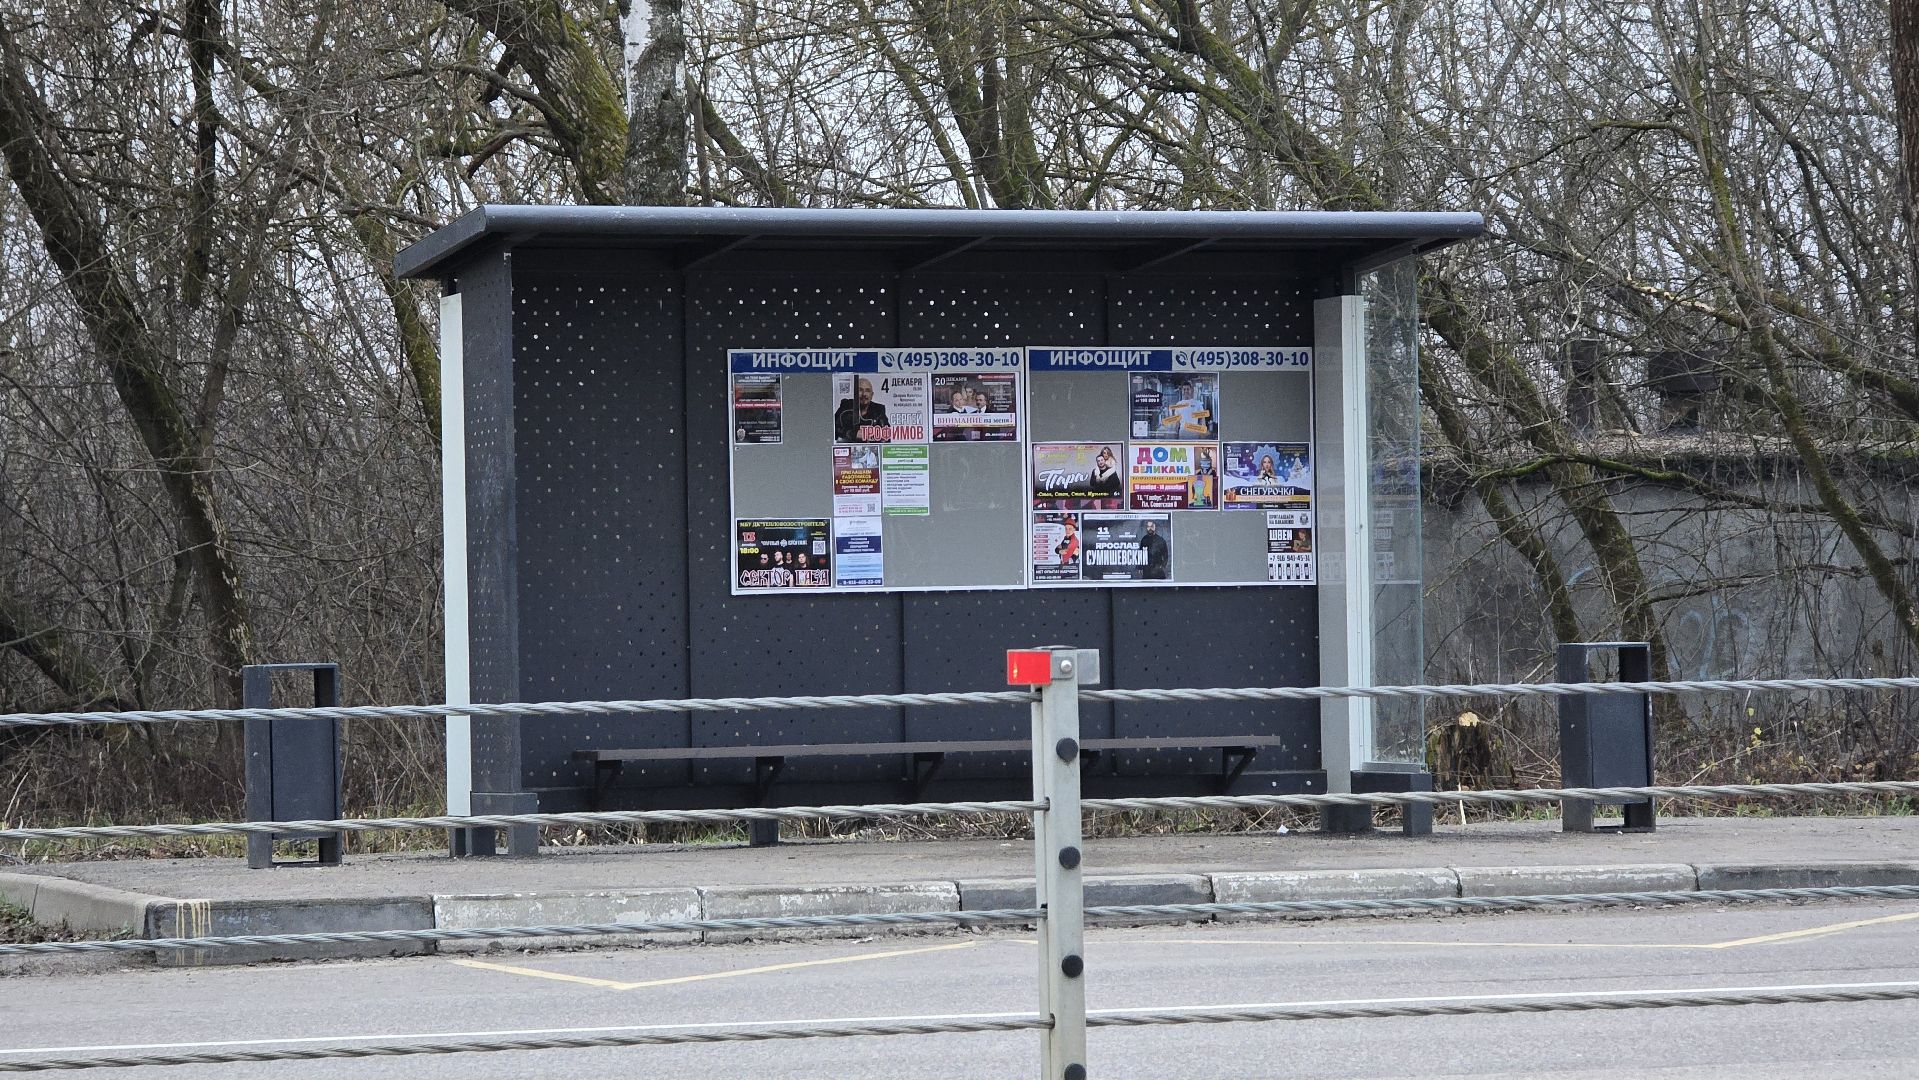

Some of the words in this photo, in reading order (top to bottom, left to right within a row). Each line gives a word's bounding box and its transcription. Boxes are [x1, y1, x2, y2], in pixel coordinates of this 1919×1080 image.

[752, 352, 858, 371] ИНФОЩИТ
[897, 351, 1020, 371] (495)308-30-10
[1050, 350, 1152, 369] ИНФОЩИТ
[1190, 350, 1309, 369] (495)308-30-10
[881, 377, 890, 393] 4
[891, 377, 923, 387] ДЕКАБРЯ
[935, 377, 946, 386] 20
[890, 410, 923, 425] СЕРГЕЙ
[859, 425, 924, 441] ТРОФИМОВ
[1136, 446, 1188, 465] ДОМ
[1226, 446, 1232, 454] 3
[1132, 465, 1191, 474] ВЕЛИКАНА
[1038, 467, 1089, 491] Пара
[1240, 487, 1295, 496] СНЕГУРОЧКА
[1097, 526, 1110, 535] 11
[1095, 542, 1140, 550] ЯРОСЛАВ
[1086, 546, 1149, 566] СУМИШЕВСКИЙ
[740, 569, 792, 587] СЕКТОР
[794, 568, 830, 586] ГАЗА
